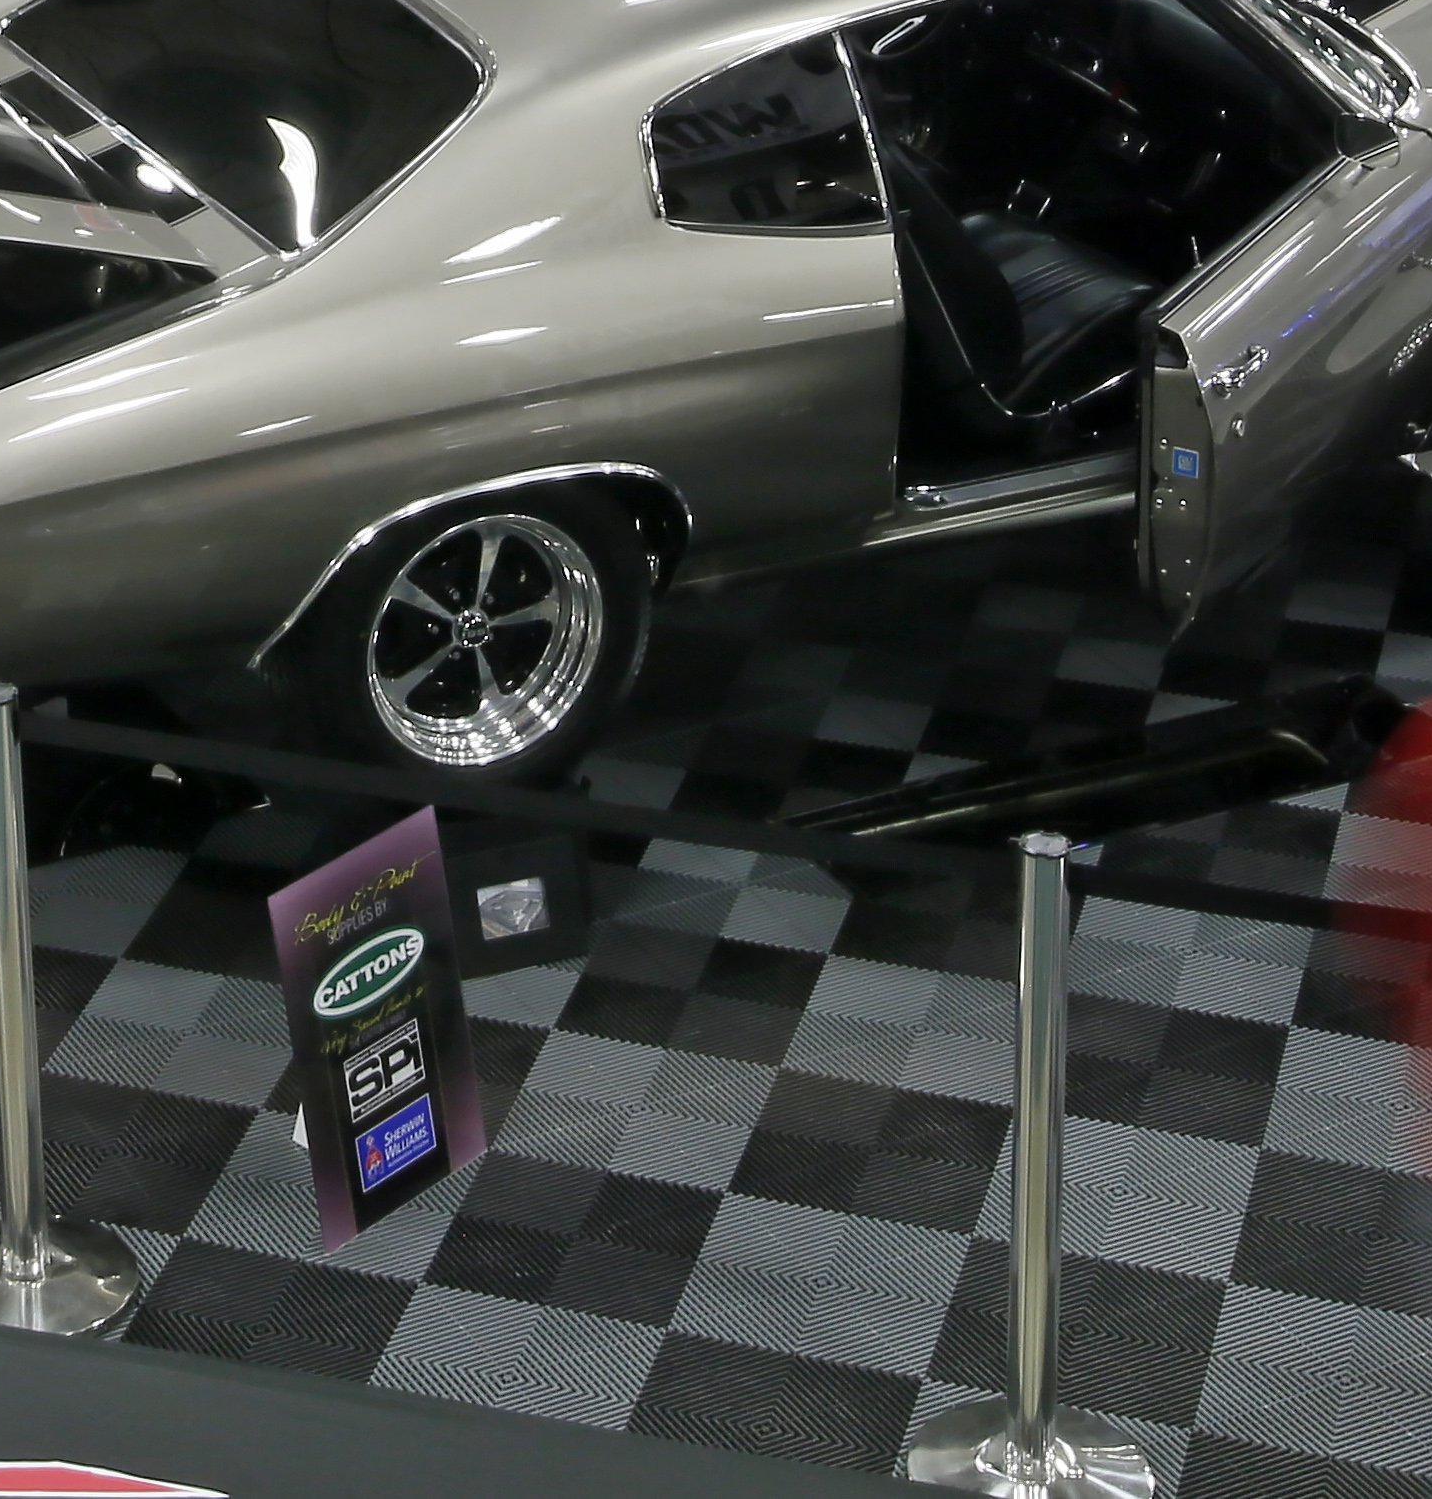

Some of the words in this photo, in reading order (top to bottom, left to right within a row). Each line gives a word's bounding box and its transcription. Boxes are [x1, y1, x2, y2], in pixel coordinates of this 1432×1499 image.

[295, 903, 345, 946] Body
[326, 905, 375, 945] SUPPLIES
[320, 934, 421, 1006] CATTONS
[383, 1112, 426, 1146] SHERWIN
